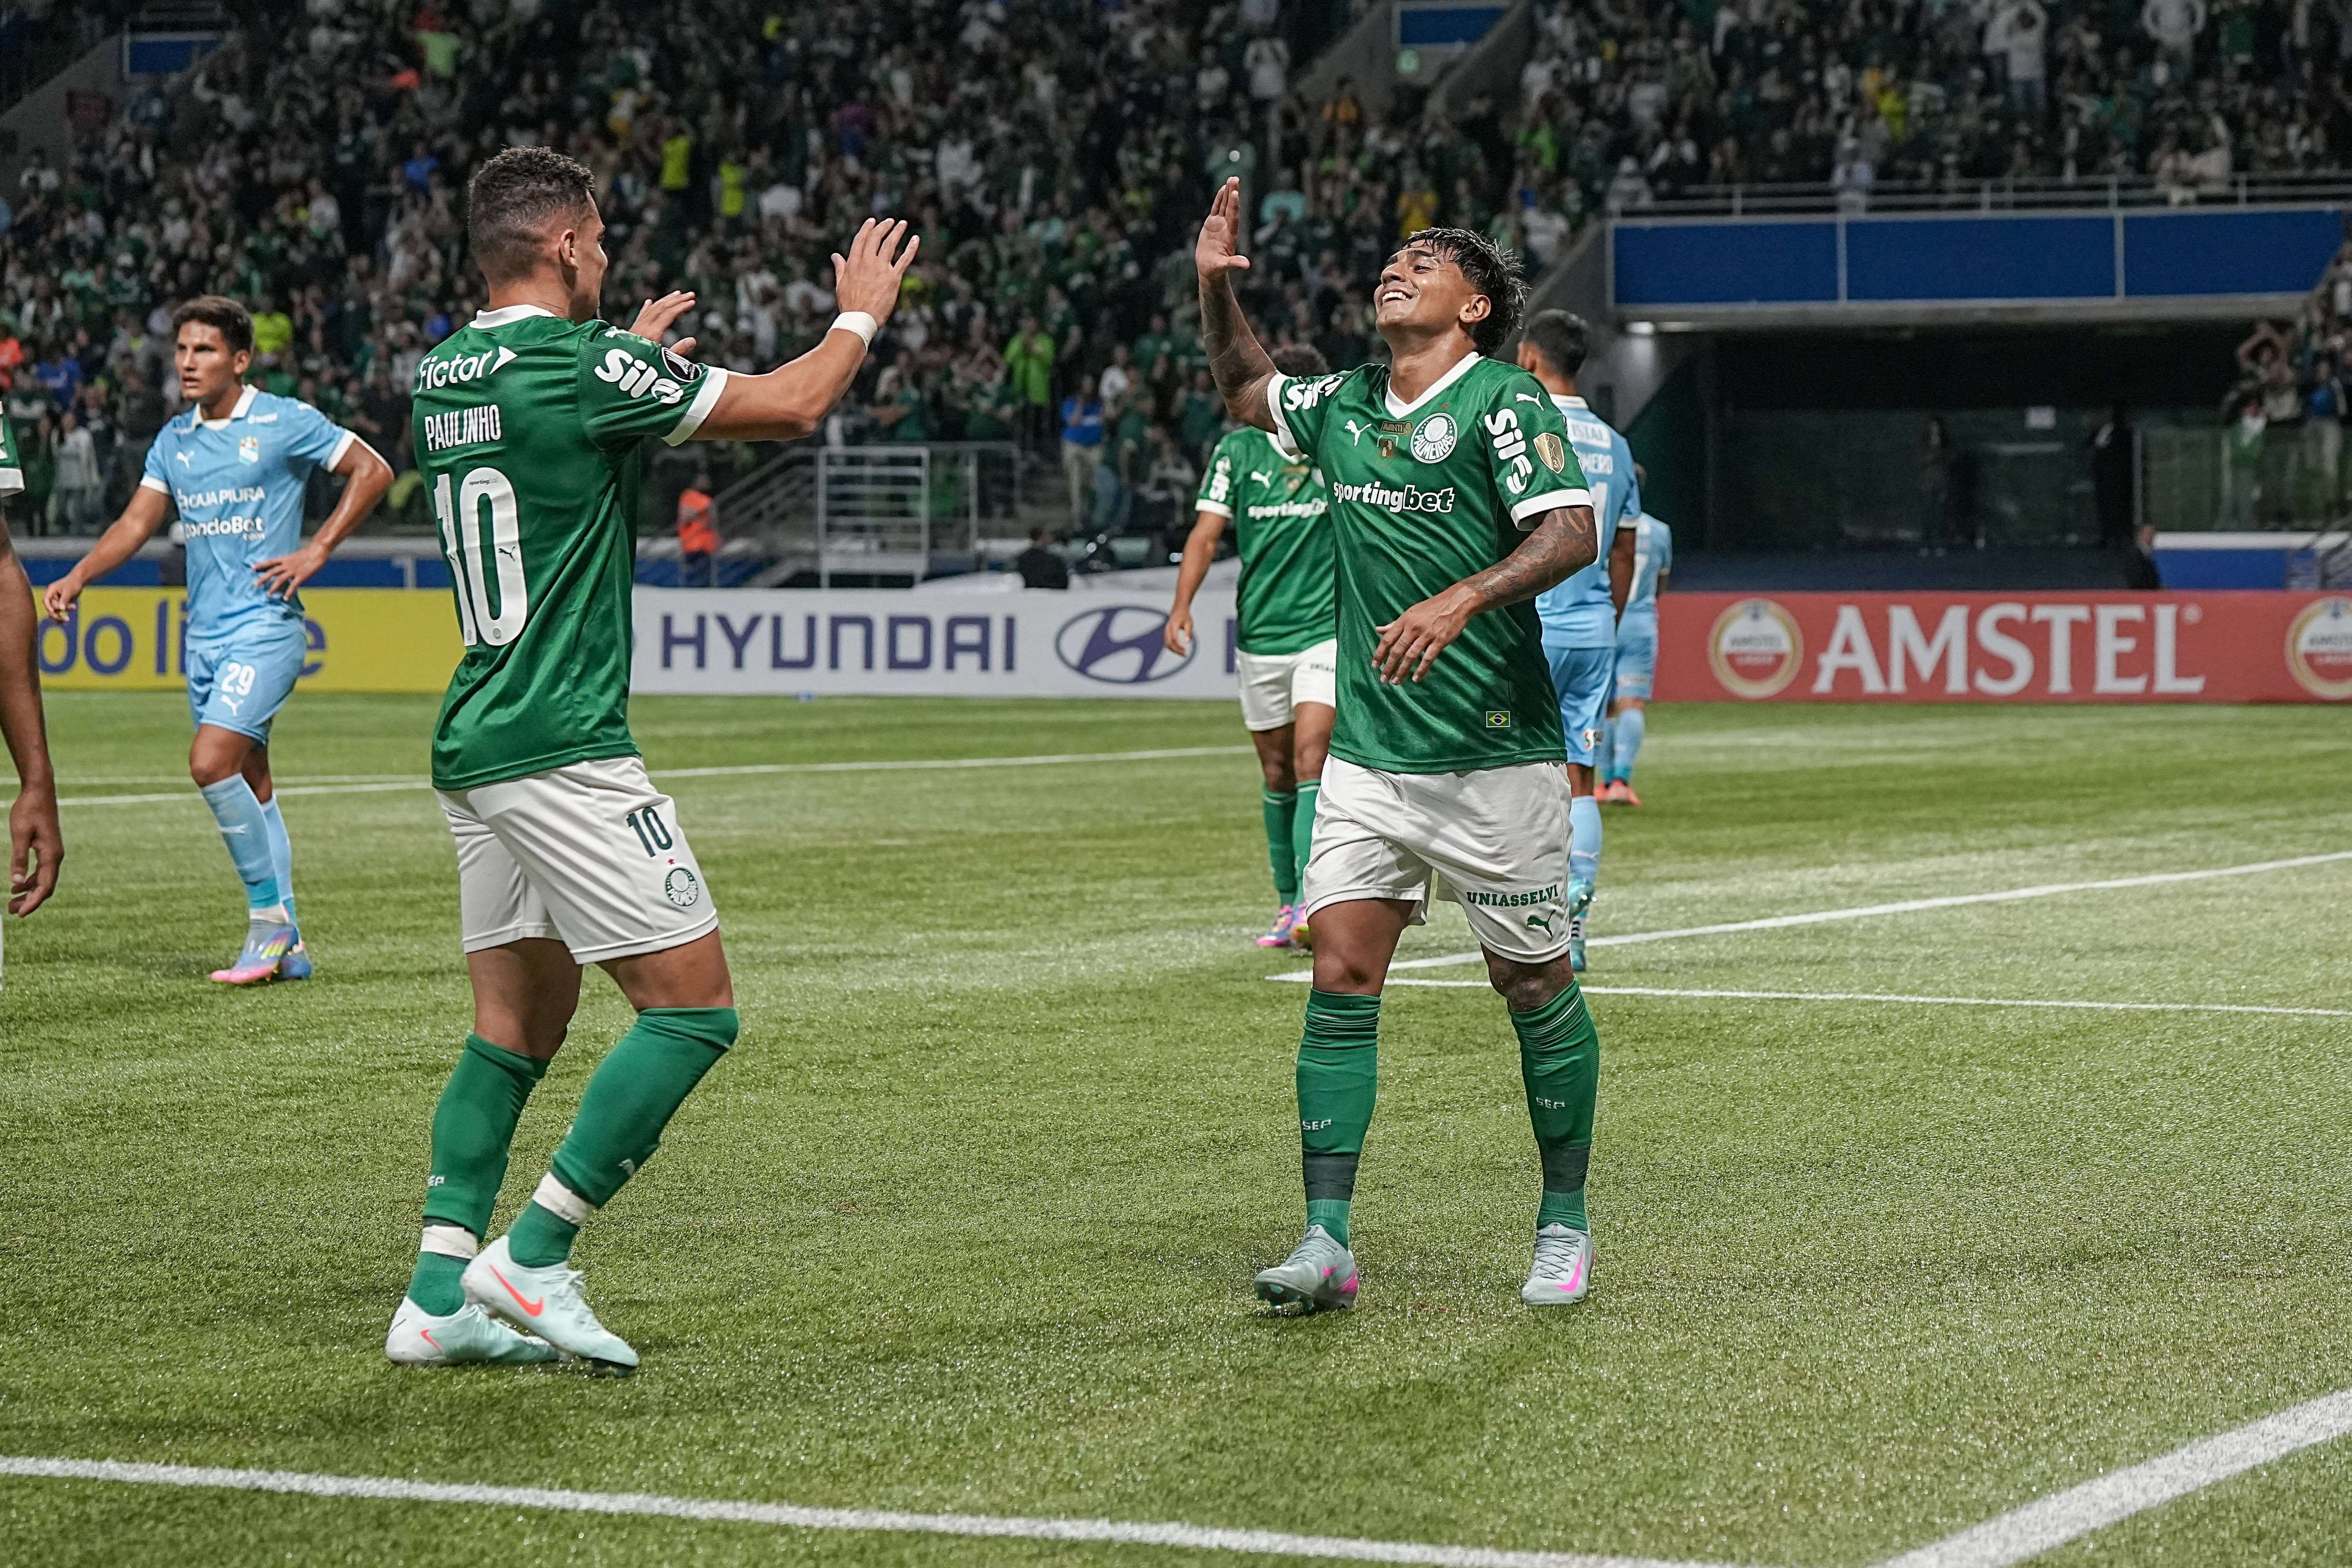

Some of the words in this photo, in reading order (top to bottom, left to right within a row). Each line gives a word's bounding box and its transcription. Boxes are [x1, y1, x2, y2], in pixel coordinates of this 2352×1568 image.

[425, 404, 501, 451] PAULINHO
[1383, 423, 1403, 432] AVANTI
[1413, 434, 1454, 460] PALMEIRAS
[1553, 459, 1558, 468] 3
[1333, 481, 1455, 513] sportingbet
[433, 467, 528, 646] 10
[661, 614, 1014, 671] HYUNDAI
[1811, 602, 2206, 695] AMSTEL
[221, 662, 256, 696] 29
[626, 806, 673, 858] 10
[1467, 884, 1559, 907] UNIASSELVI
[1536, 1097, 1566, 1110] SEP
[1302, 1119, 1332, 1131] SEP
